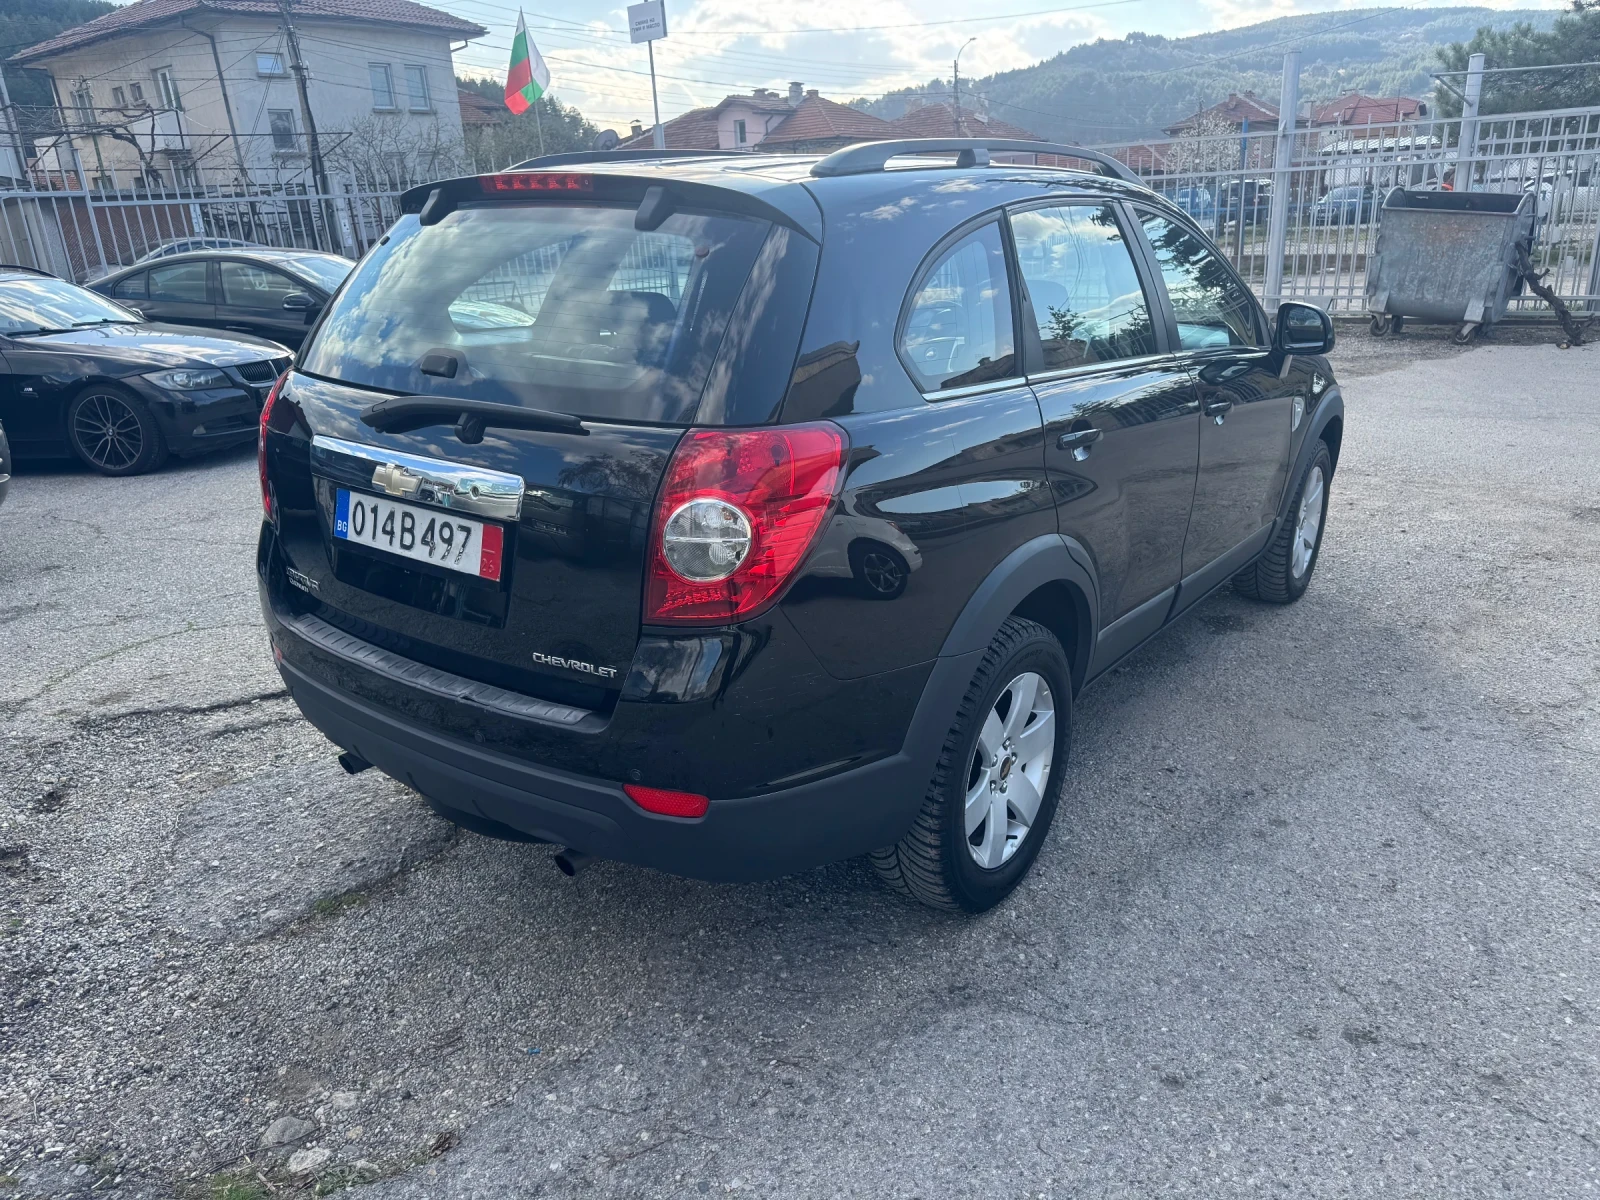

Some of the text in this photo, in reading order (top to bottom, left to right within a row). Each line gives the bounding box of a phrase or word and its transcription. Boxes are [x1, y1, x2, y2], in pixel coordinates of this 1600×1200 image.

[337, 519, 348, 533] BG
[352, 500, 472, 565] 014B497
[480, 557, 495, 573] 26
[532, 652, 618, 679] CHEVROLET
